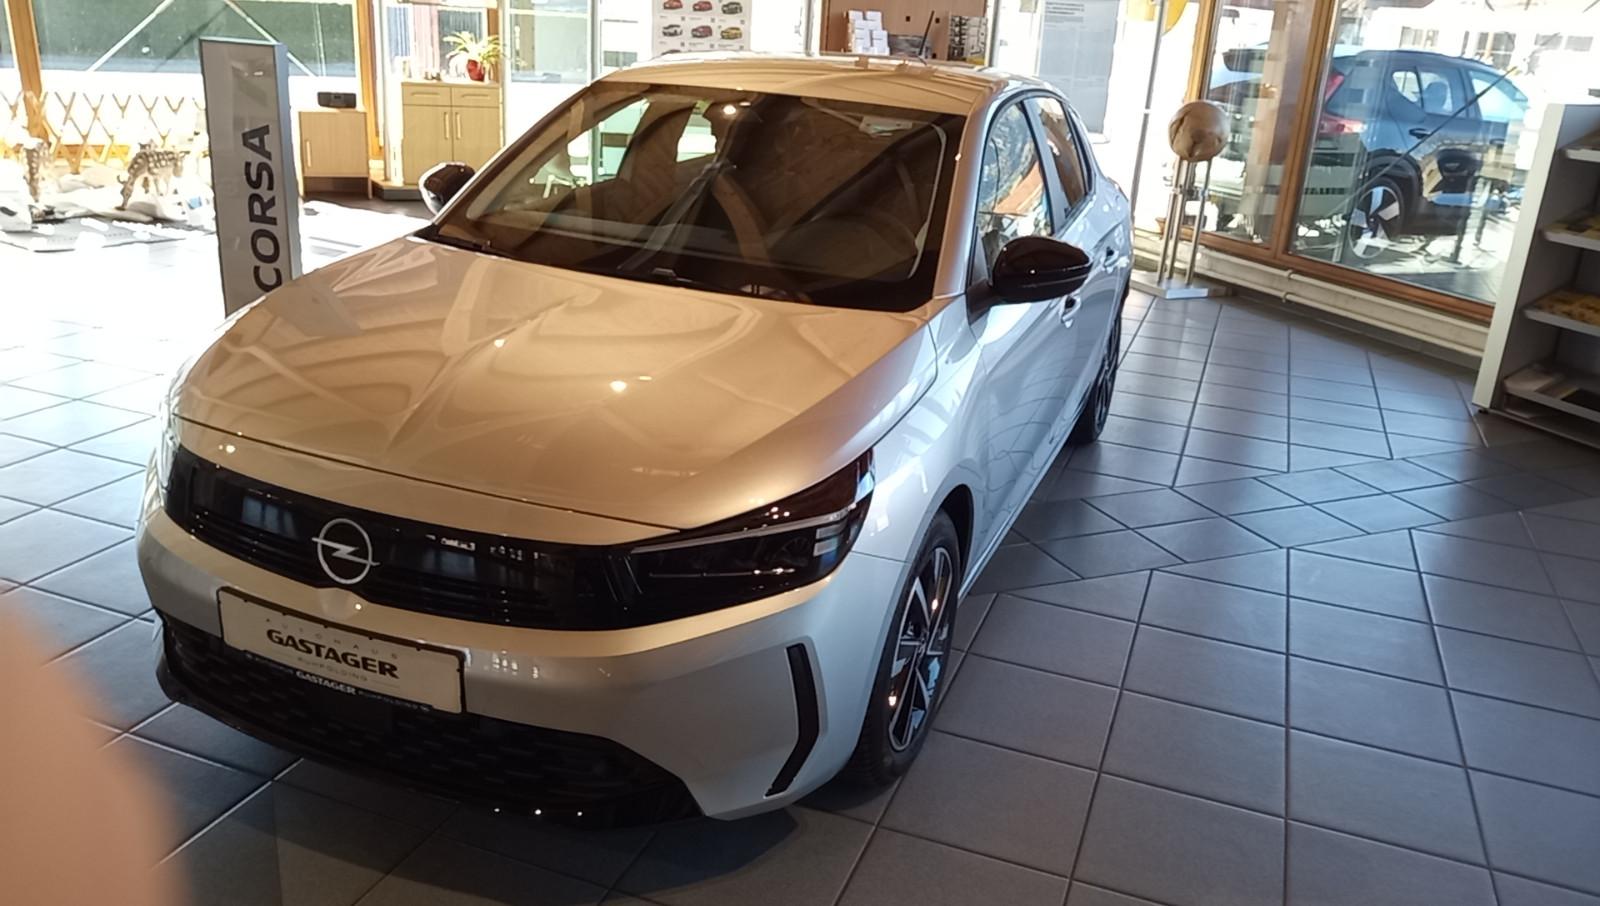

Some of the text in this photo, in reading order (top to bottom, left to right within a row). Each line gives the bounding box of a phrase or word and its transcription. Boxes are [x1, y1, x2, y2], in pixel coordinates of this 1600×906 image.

[242, 124, 283, 292] CORSA
[266, 628, 400, 680] GASTAGER
[296, 670, 357, 696] GASTAGER
